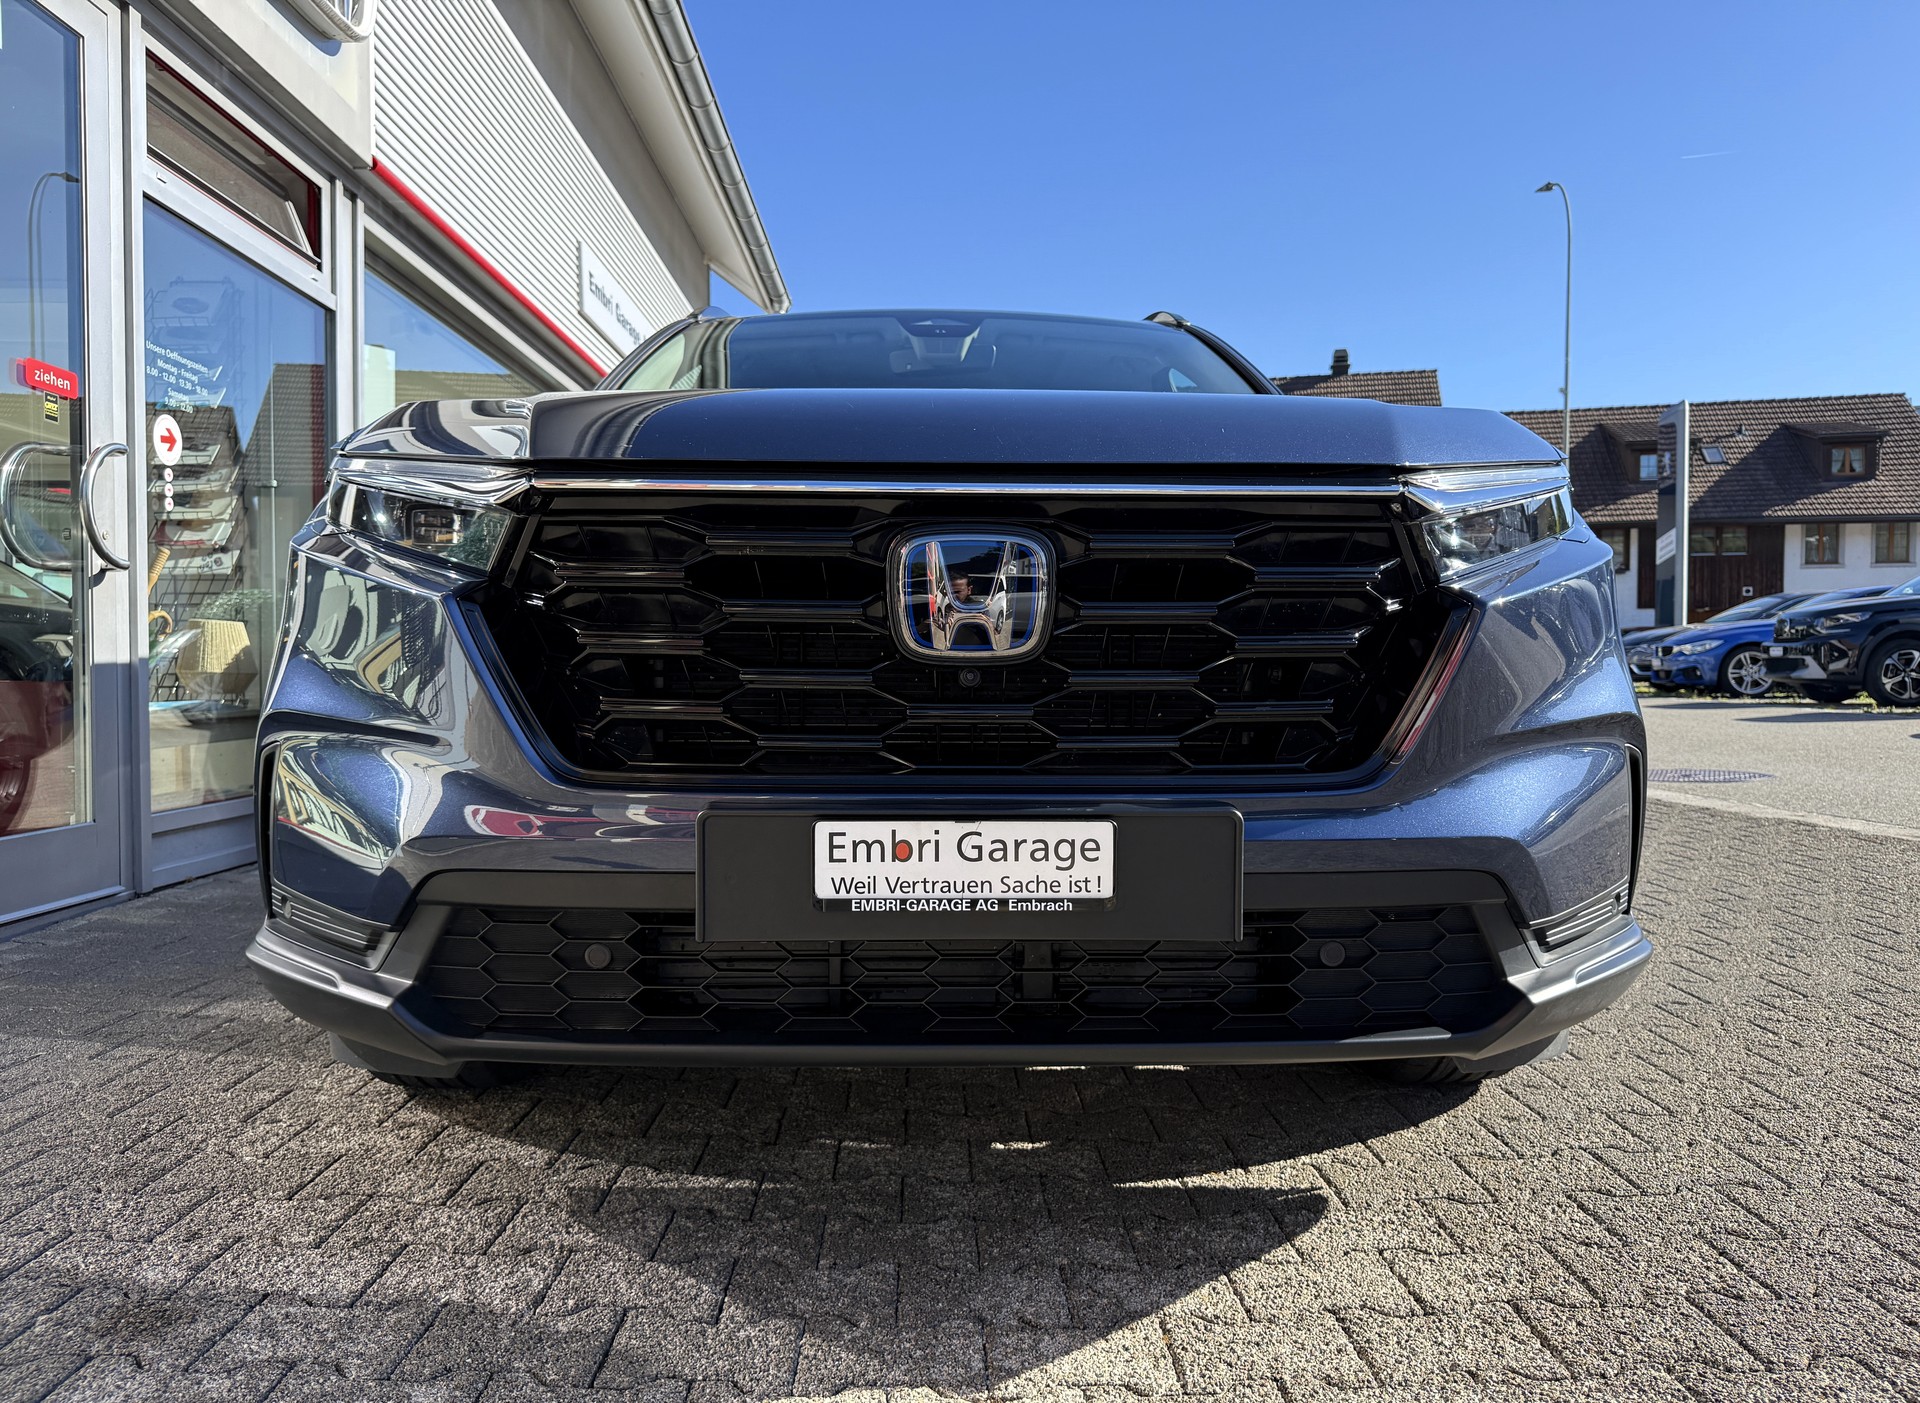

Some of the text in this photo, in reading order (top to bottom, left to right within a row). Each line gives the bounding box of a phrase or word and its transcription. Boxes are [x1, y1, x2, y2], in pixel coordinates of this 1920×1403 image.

[587, 270, 613, 315] Embri
[146, 340, 209, 374] Unsere Oeffnungszeiten
[34, 368, 71, 391] ziehen
[146, 365, 159, 377] 8.00
[162, 372, 177, 384] 12.00
[157, 358, 178, 376] Montag
[181, 368, 199, 384] Freitag
[828, 829, 1101, 872] Embri Garage
[831, 875, 876, 895] Weil
[885, 876, 993, 894] Vertrauen
[1000, 874, 1062, 894] Sache
[1068, 874, 1092, 894] ist
[851, 898, 1073, 912] EMBRI-GARAGE AG Embrach
